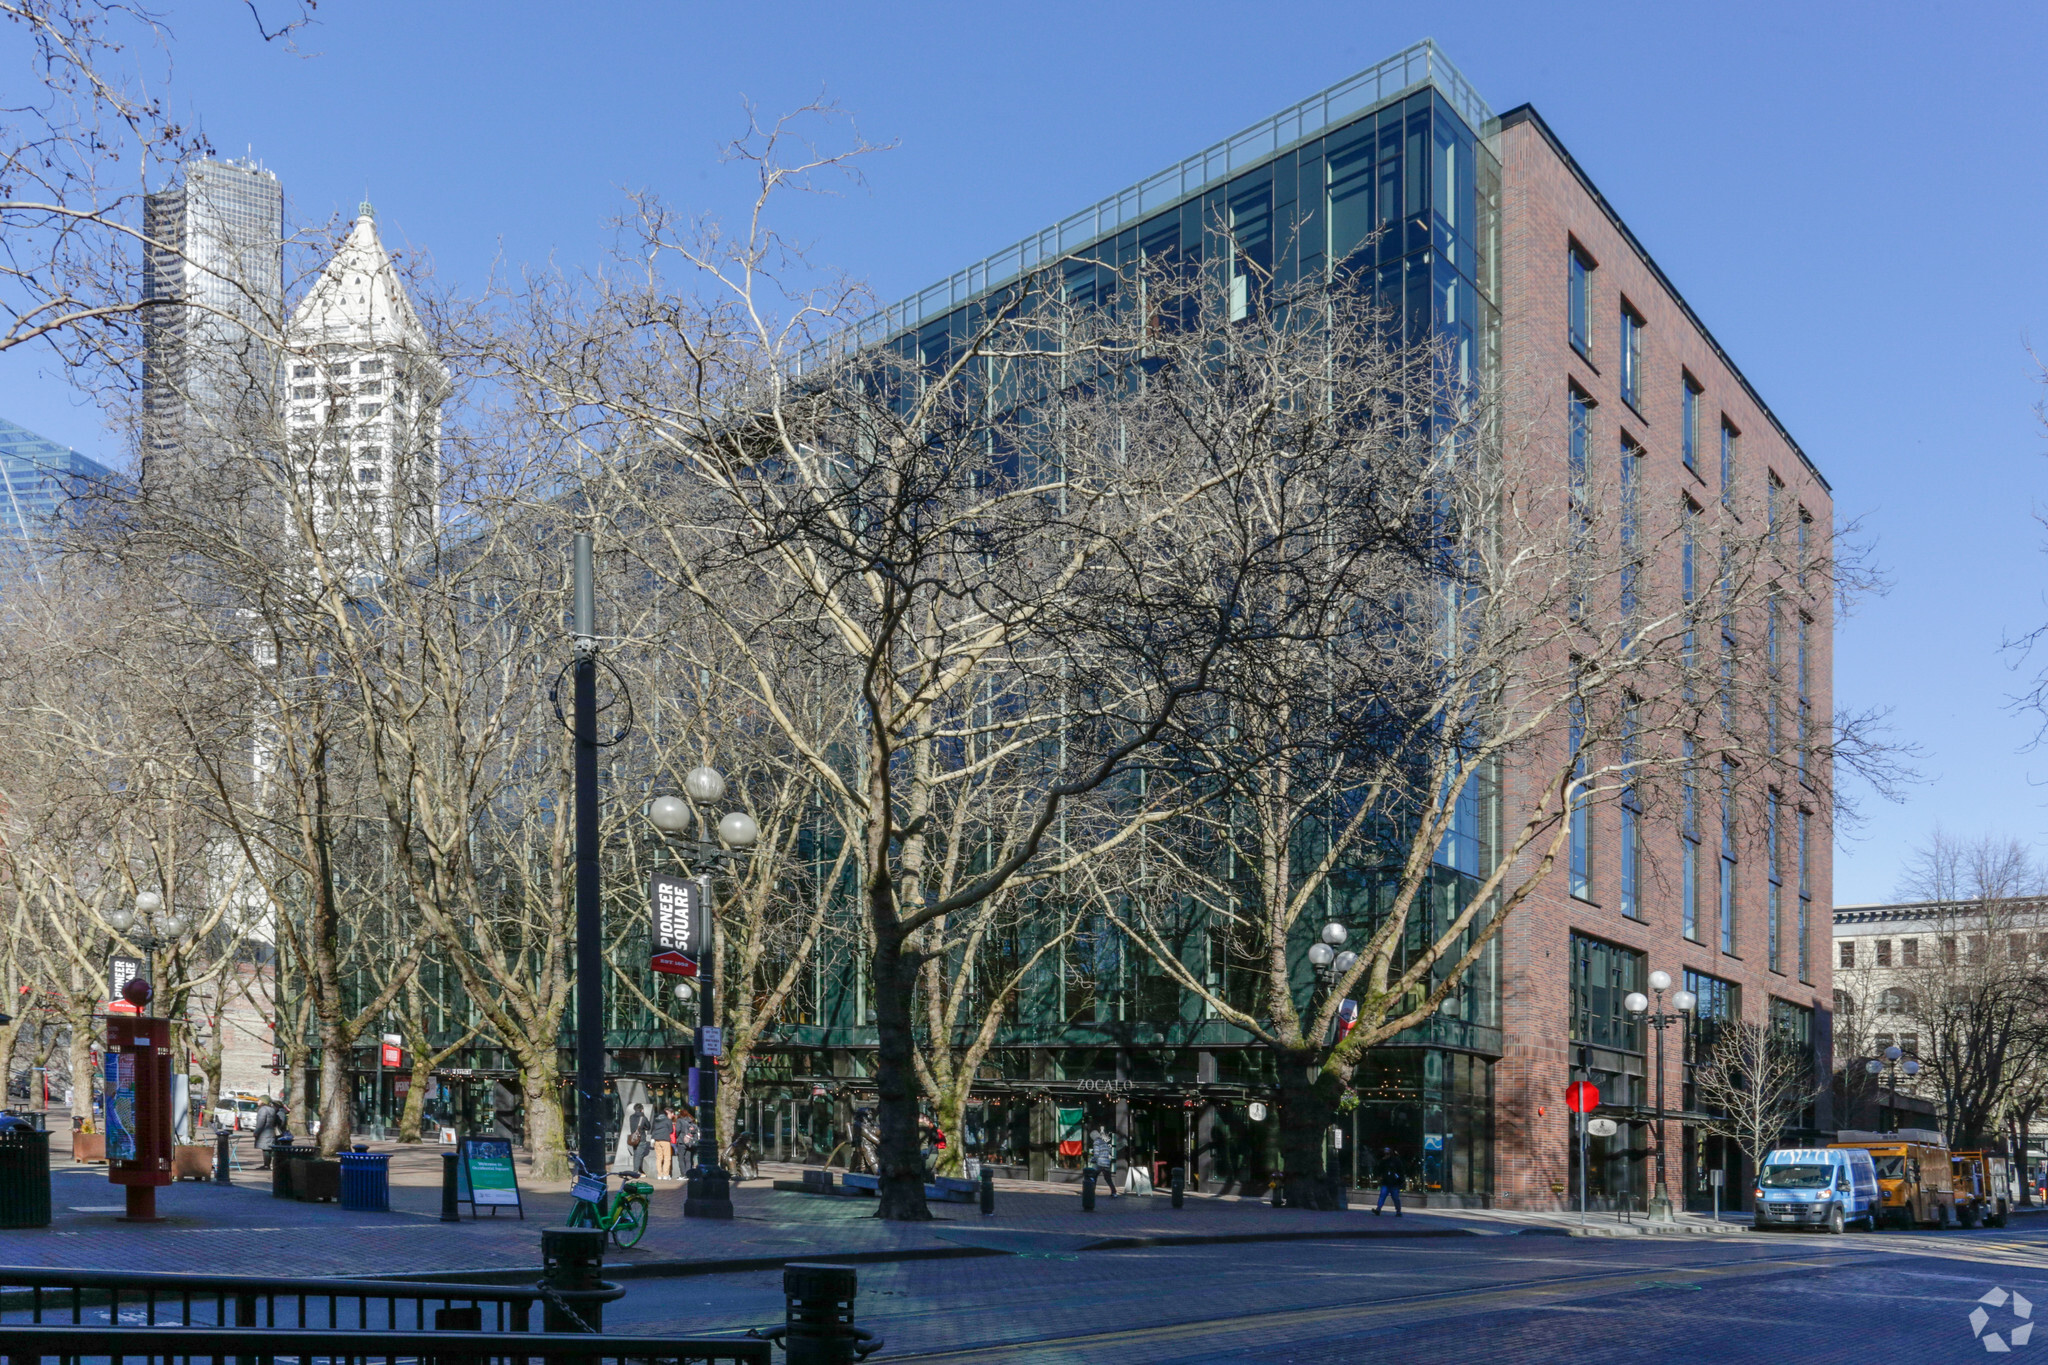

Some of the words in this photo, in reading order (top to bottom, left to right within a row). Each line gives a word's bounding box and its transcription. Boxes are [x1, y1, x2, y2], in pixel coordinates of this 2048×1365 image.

[659, 883, 674, 948] PIONEER
[674, 886, 690, 951] SQUARE
[114, 961, 125, 998] PIONEER
[1077, 1079, 1133, 1091] ZOCALO
